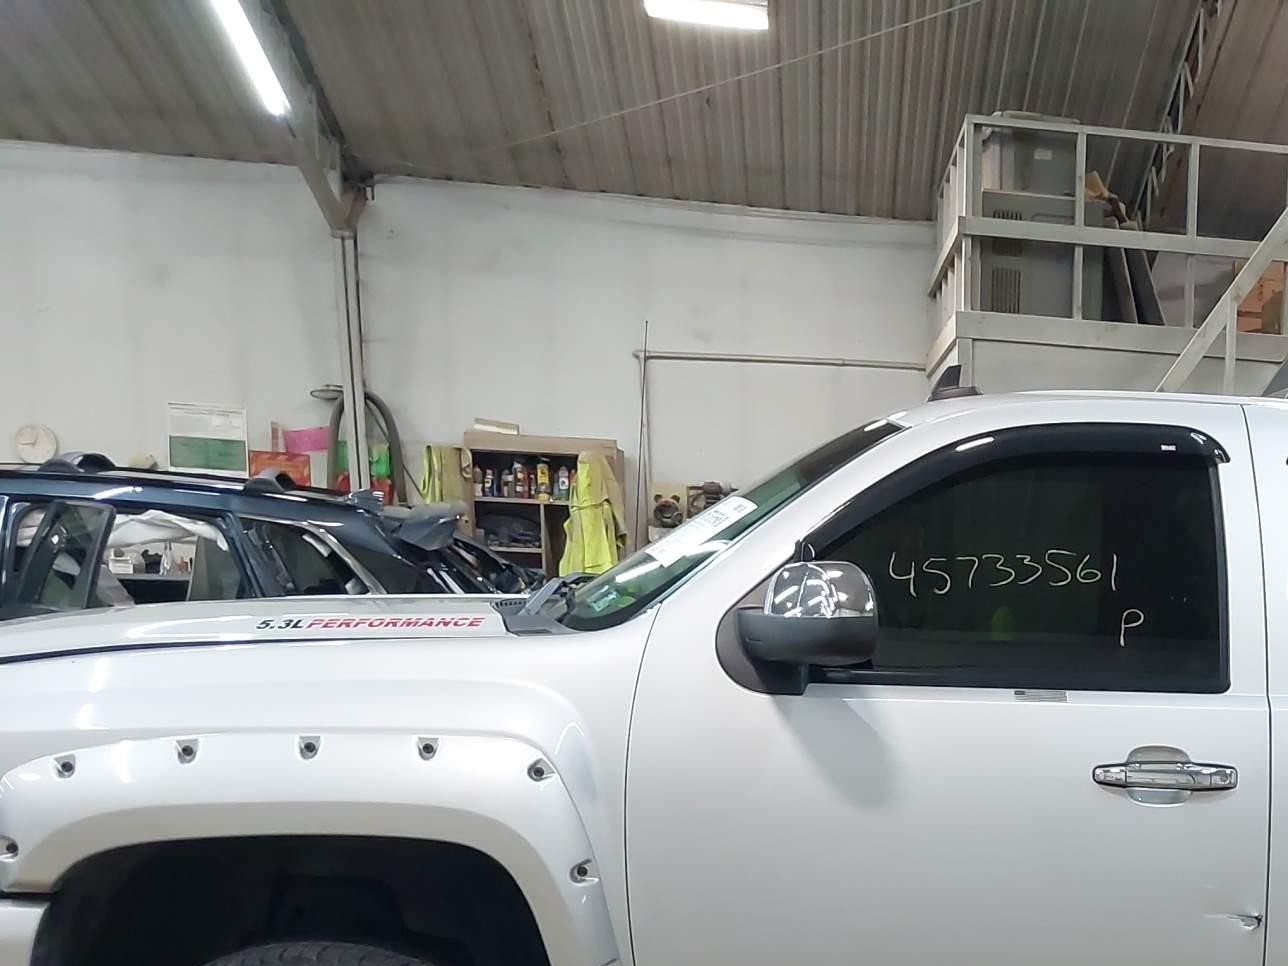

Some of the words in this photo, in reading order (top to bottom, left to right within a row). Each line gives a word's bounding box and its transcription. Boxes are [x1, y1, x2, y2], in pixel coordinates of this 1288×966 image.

[888, 549, 1119, 598] 45733561
[255, 618, 304, 630] 5.3L
[306, 617, 485, 629] PERFORMANCE
